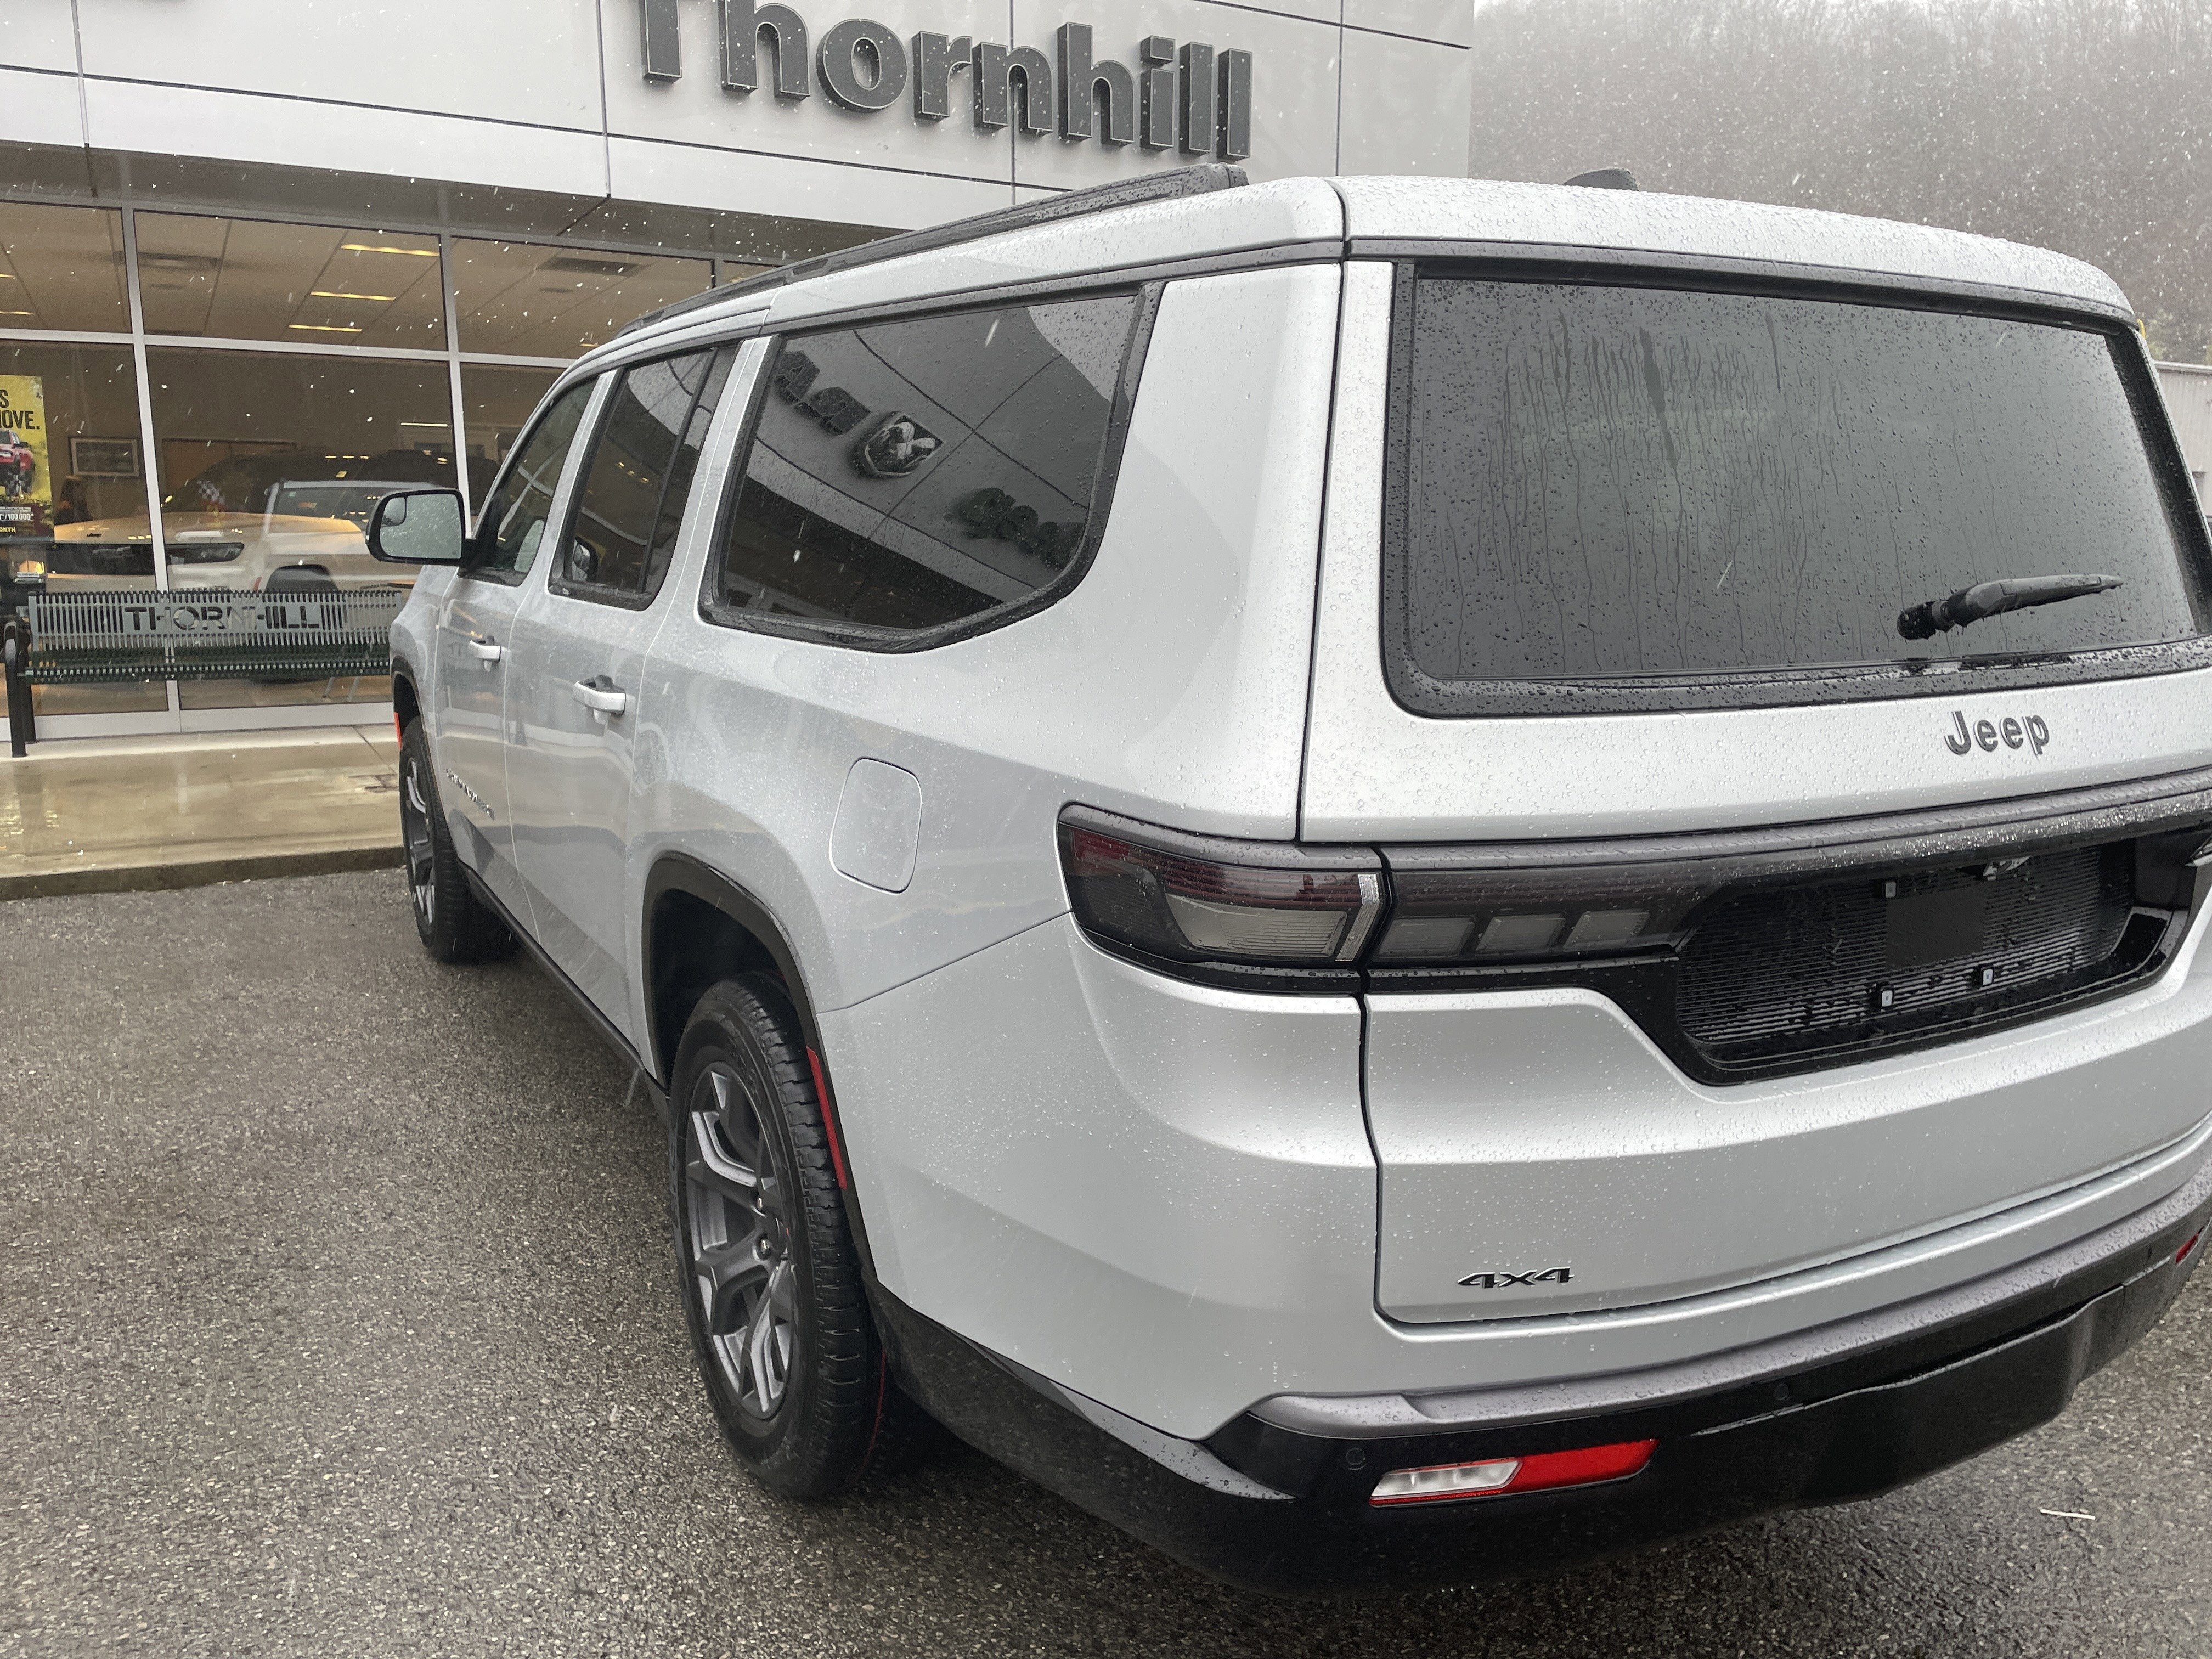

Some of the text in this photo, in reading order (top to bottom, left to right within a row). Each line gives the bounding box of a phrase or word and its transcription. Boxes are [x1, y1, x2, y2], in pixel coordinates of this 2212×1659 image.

[0, 410, 40, 430] OVE.
[125, 606, 320, 631] THORNHILL
[1944, 710, 2050, 757] Jeep
